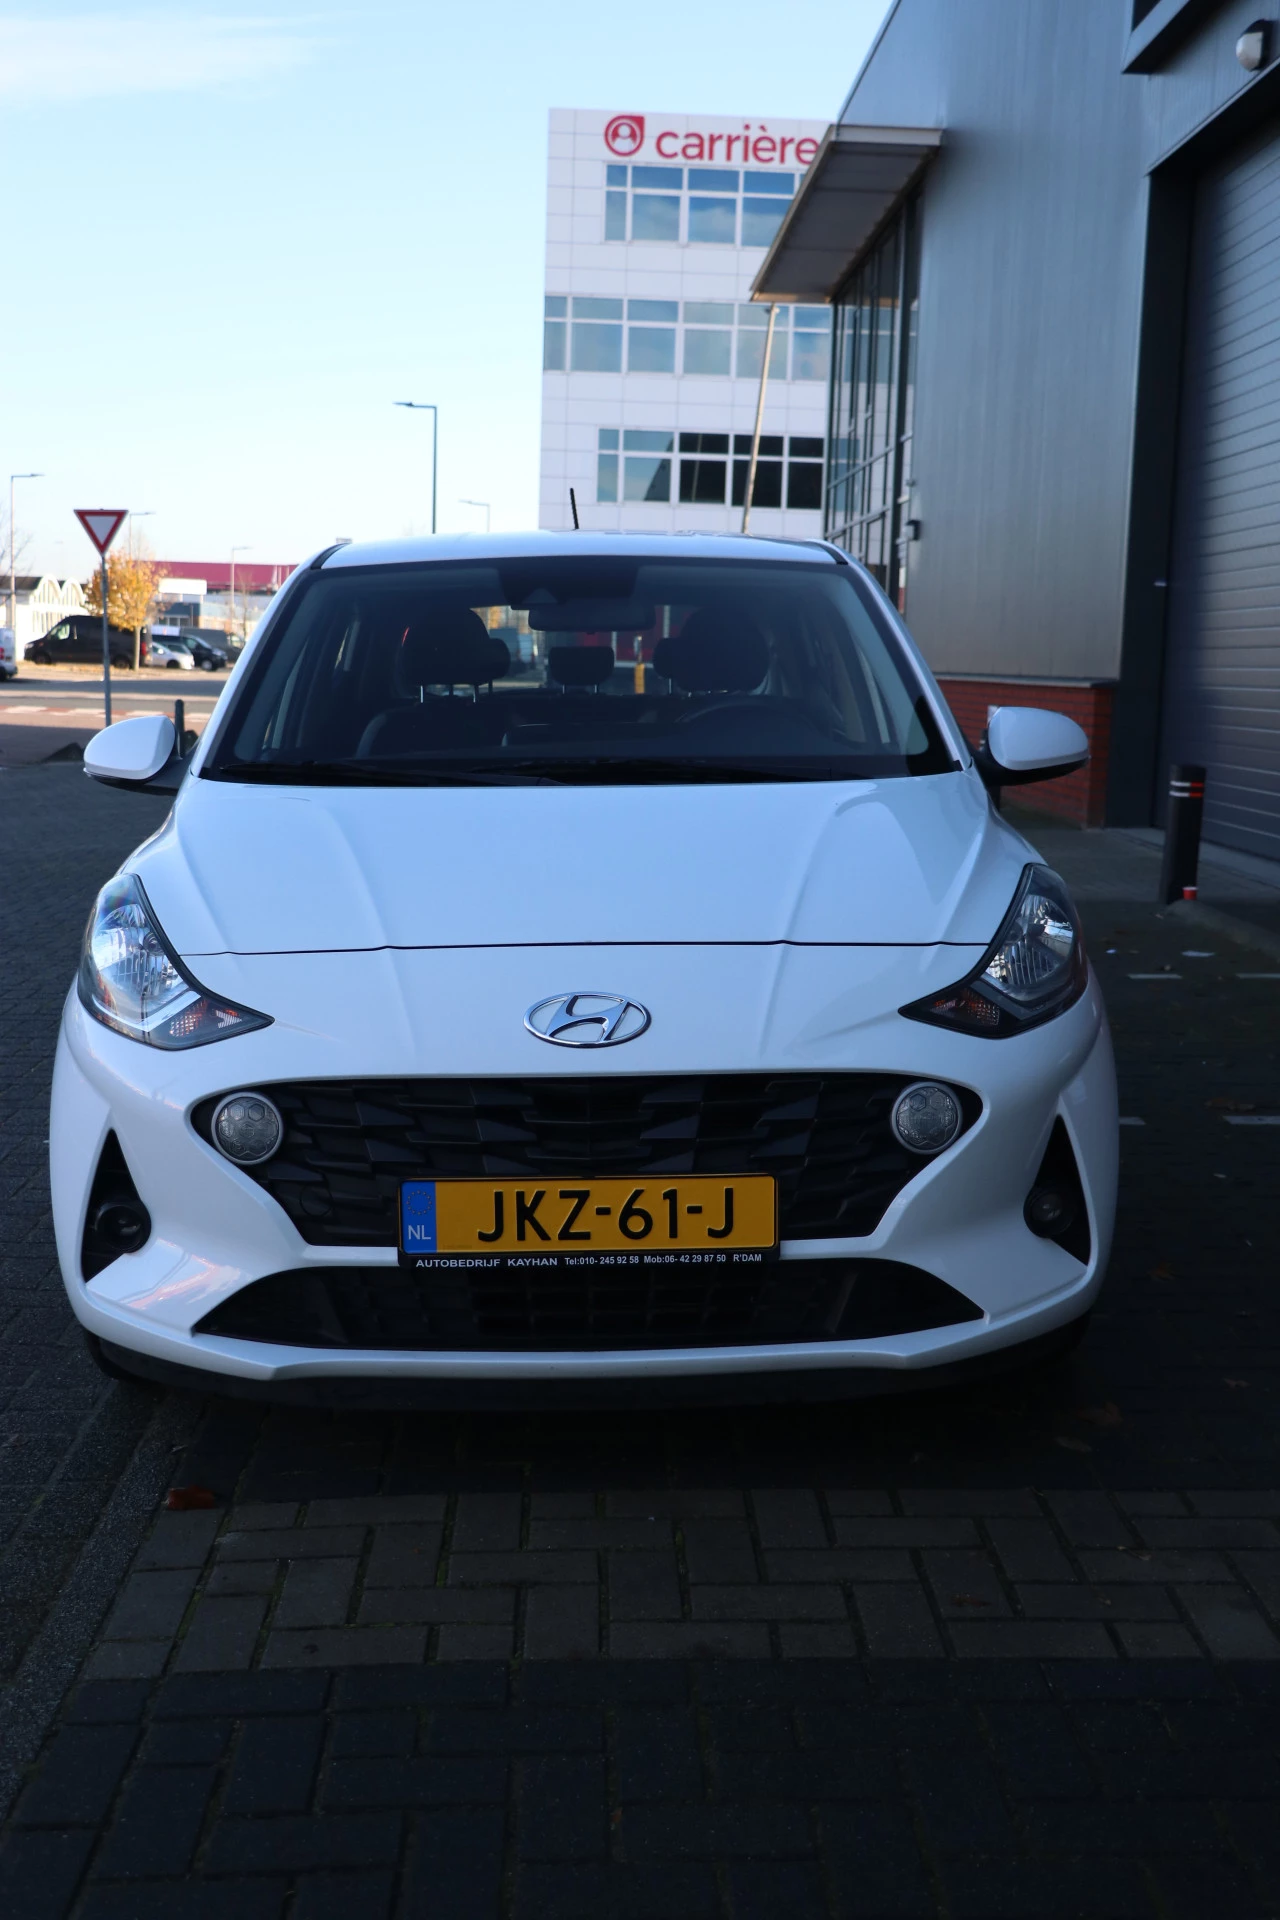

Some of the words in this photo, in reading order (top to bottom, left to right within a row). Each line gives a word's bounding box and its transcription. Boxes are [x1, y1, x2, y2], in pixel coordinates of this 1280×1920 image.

[655, 124, 820, 165] carrière
[477, 1187, 734, 1242] JKZ-61-J
[407, 1224, 432, 1240] NL
[415, 1259, 500, 1267] AUTOBEDRIJF
[507, 1257, 558, 1266] KAYHAN
[600, 1256, 615, 1265] 245
[617, 1256, 627, 1264] 92
[629, 1255, 640, 1264] 58
[680, 1254, 690, 1263] 42
[692, 1254, 702, 1263] 29
[704, 1254, 714, 1262] 87
[716, 1254, 727, 1262] 50
[733, 1253, 762, 1262] R'DAM
